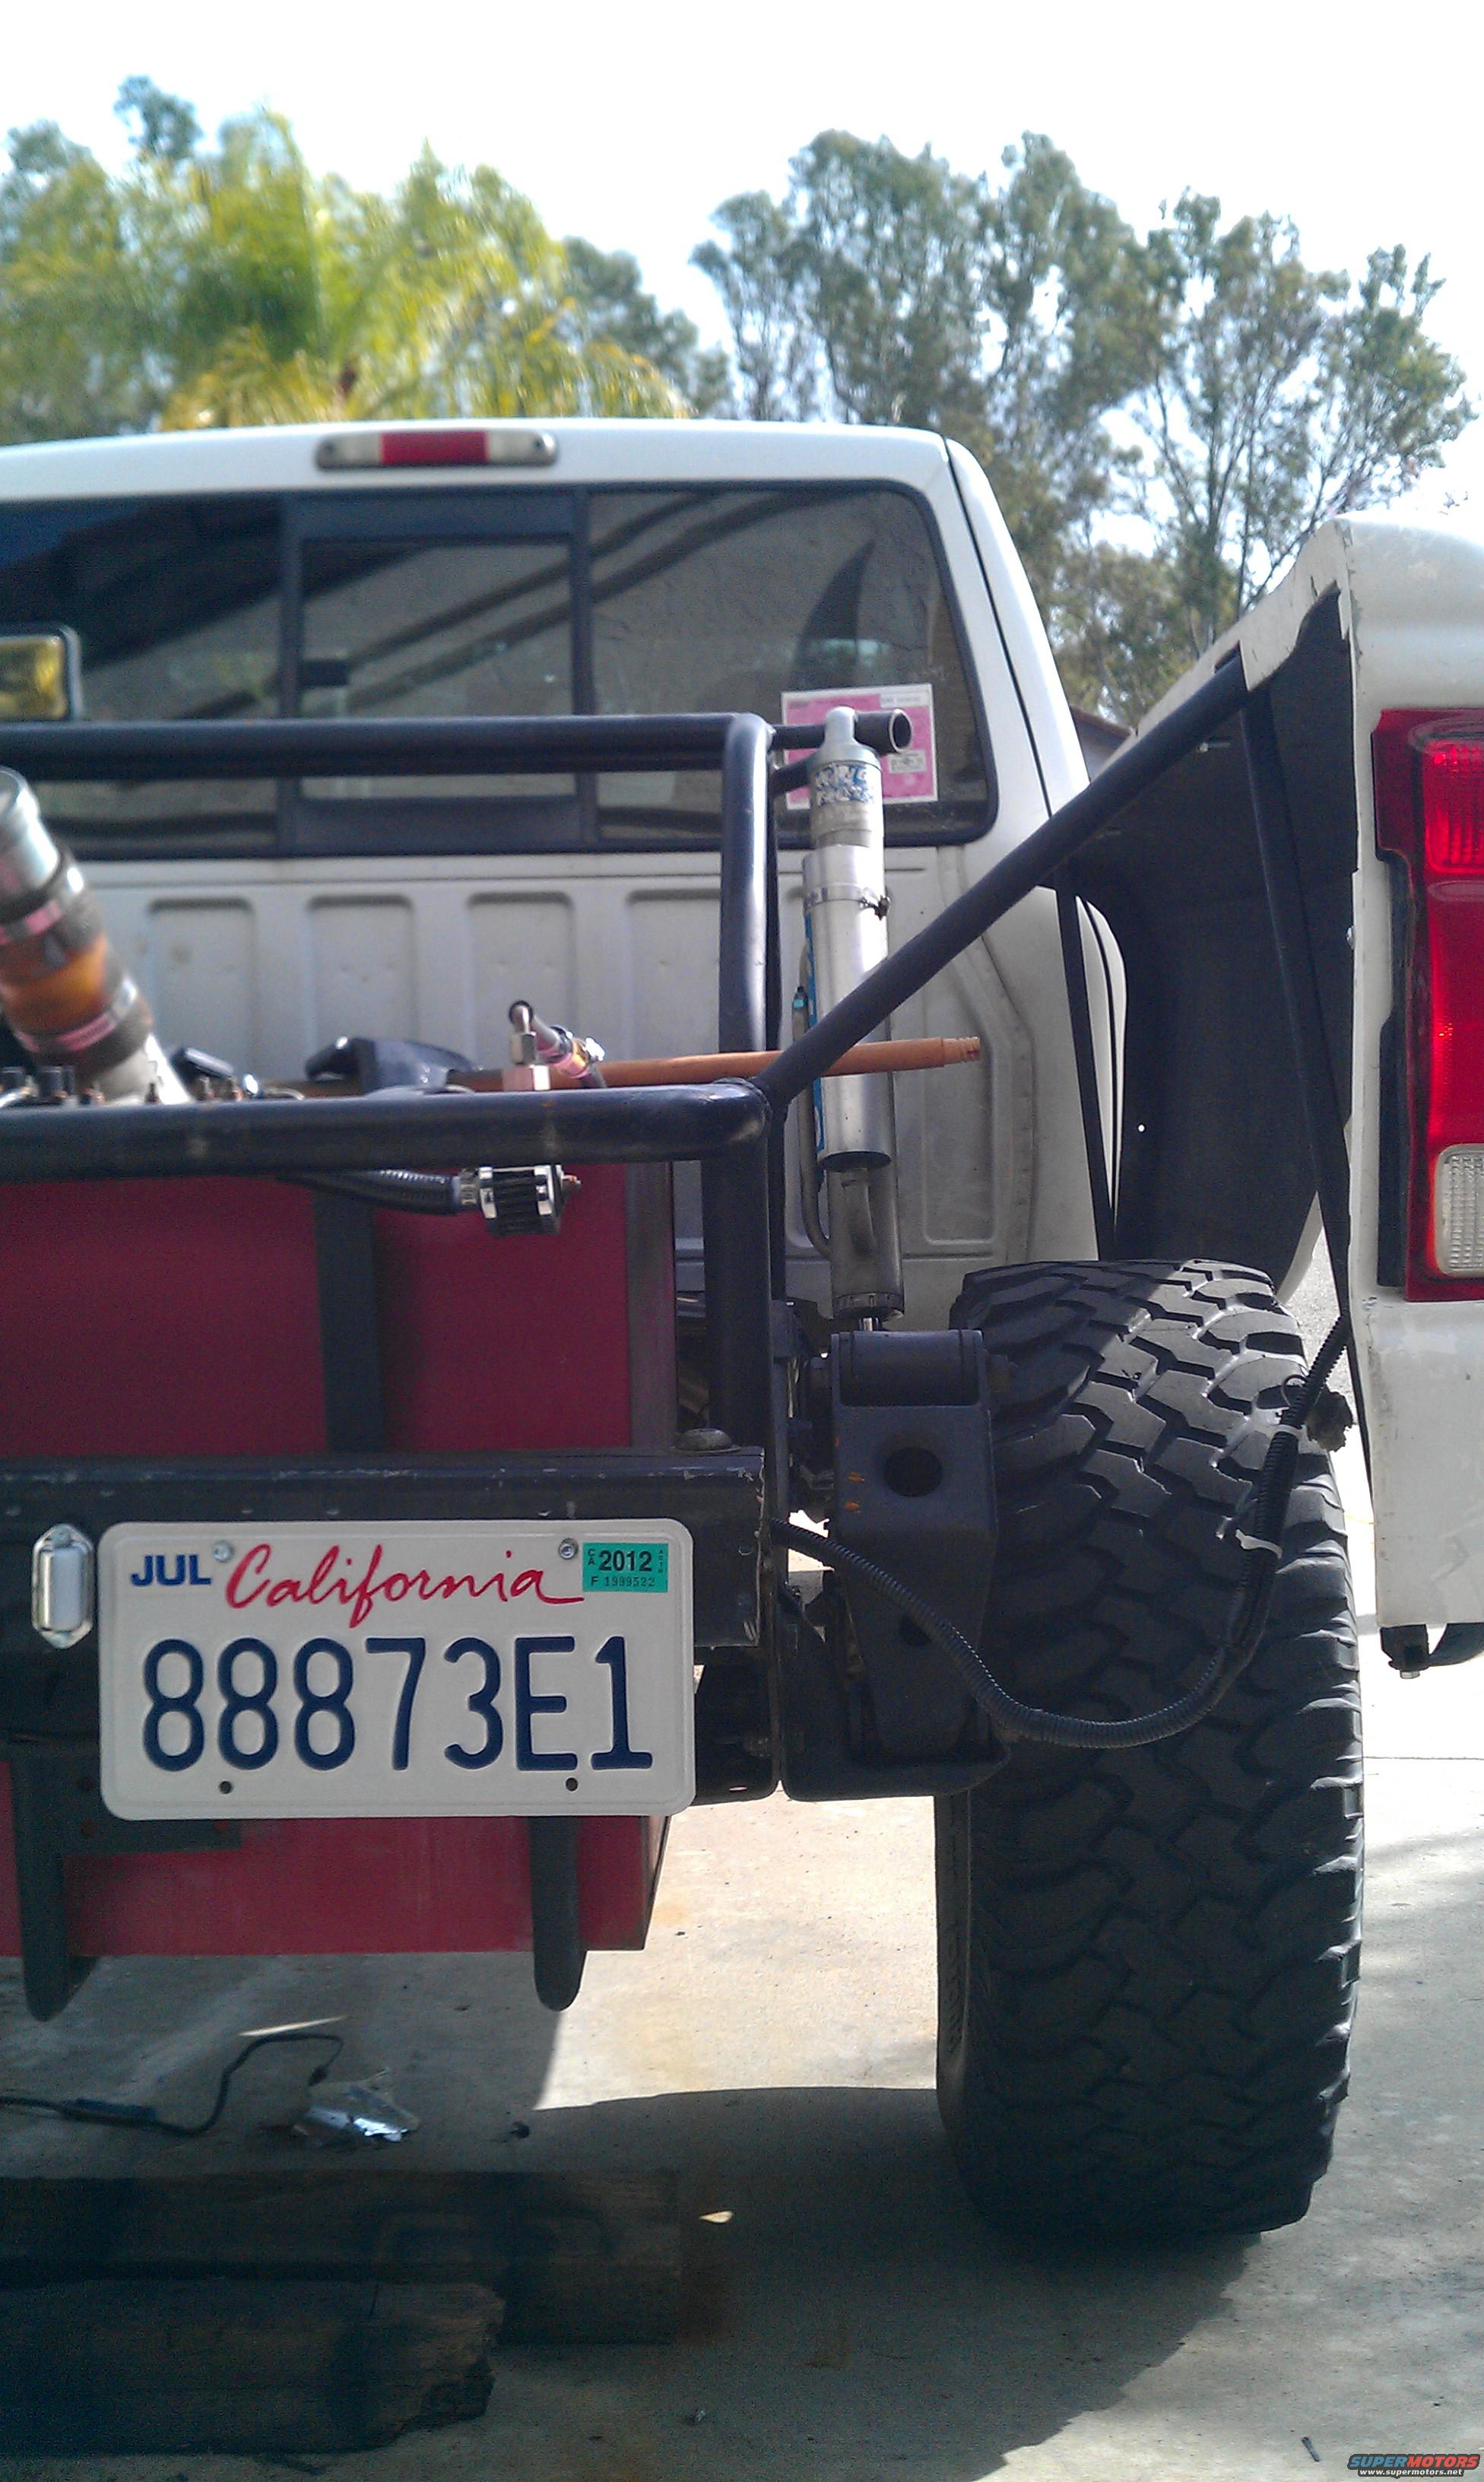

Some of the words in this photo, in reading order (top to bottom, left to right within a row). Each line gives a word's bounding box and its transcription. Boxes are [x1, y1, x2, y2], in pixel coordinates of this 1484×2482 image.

[131, 1554, 211, 1587] JUL
[225, 1543, 584, 1629] California
[599, 1550, 652, 1572] 2012
[141, 1635, 653, 1773] 88873E1
